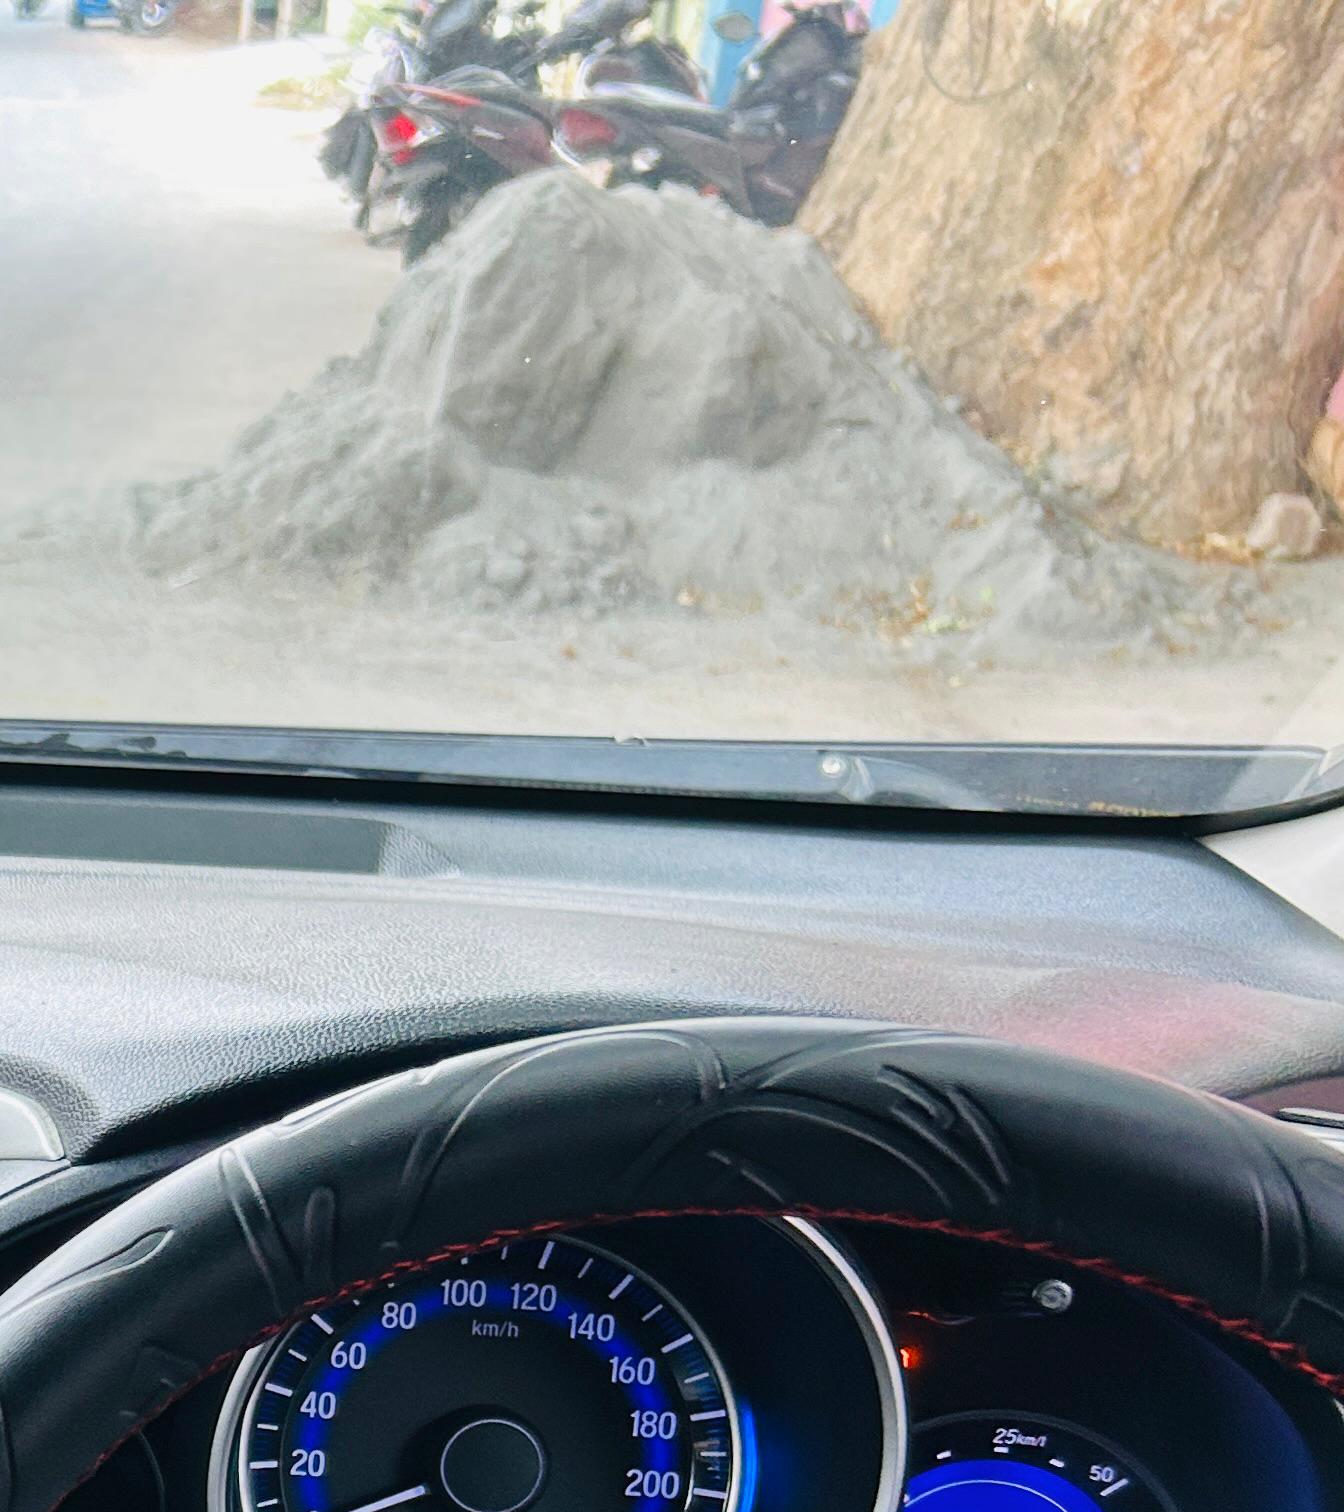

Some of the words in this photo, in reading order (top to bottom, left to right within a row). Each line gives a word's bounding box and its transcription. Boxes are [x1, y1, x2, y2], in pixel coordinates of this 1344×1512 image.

[441, 1278, 487, 1309] 100
[511, 1283, 557, 1313] 120
[381, 1301, 417, 1330] 80
[471, 1319, 519, 1338] km/h
[568, 1313, 615, 1343] 140
[330, 1341, 367, 1370] 60
[611, 1356, 655, 1386] 160
[300, 1390, 336, 1419] 40
[630, 1409, 678, 1440] 180
[290, 1450, 325, 1478] 20
[1089, 1464, 1113, 1482] 50
[625, 1470, 680, 1499] 200
